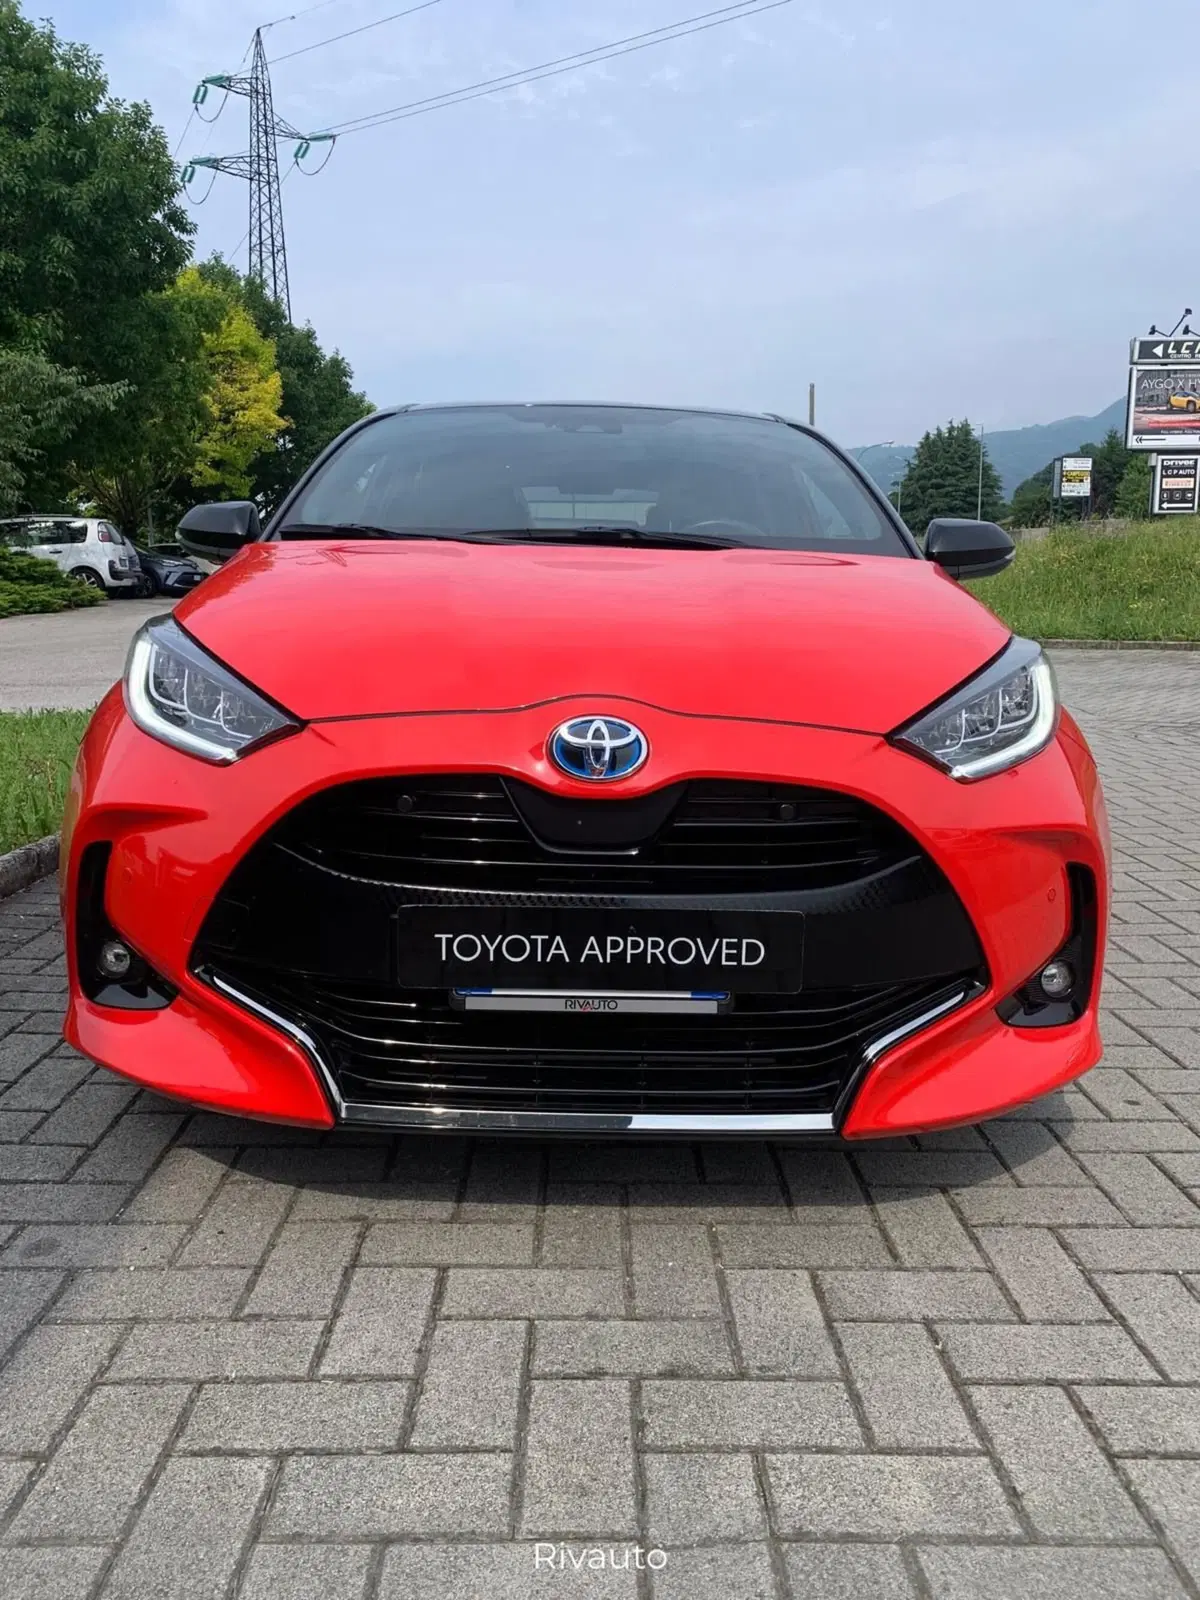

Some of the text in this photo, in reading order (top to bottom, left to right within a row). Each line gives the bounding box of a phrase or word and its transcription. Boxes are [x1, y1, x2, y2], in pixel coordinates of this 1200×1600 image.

[1141, 378, 1174, 389] AYGO
[1177, 378, 1185, 389] X
[433, 934, 766, 966] TOYOTA APPROVED
[564, 999, 619, 1011] RIVAUTO
